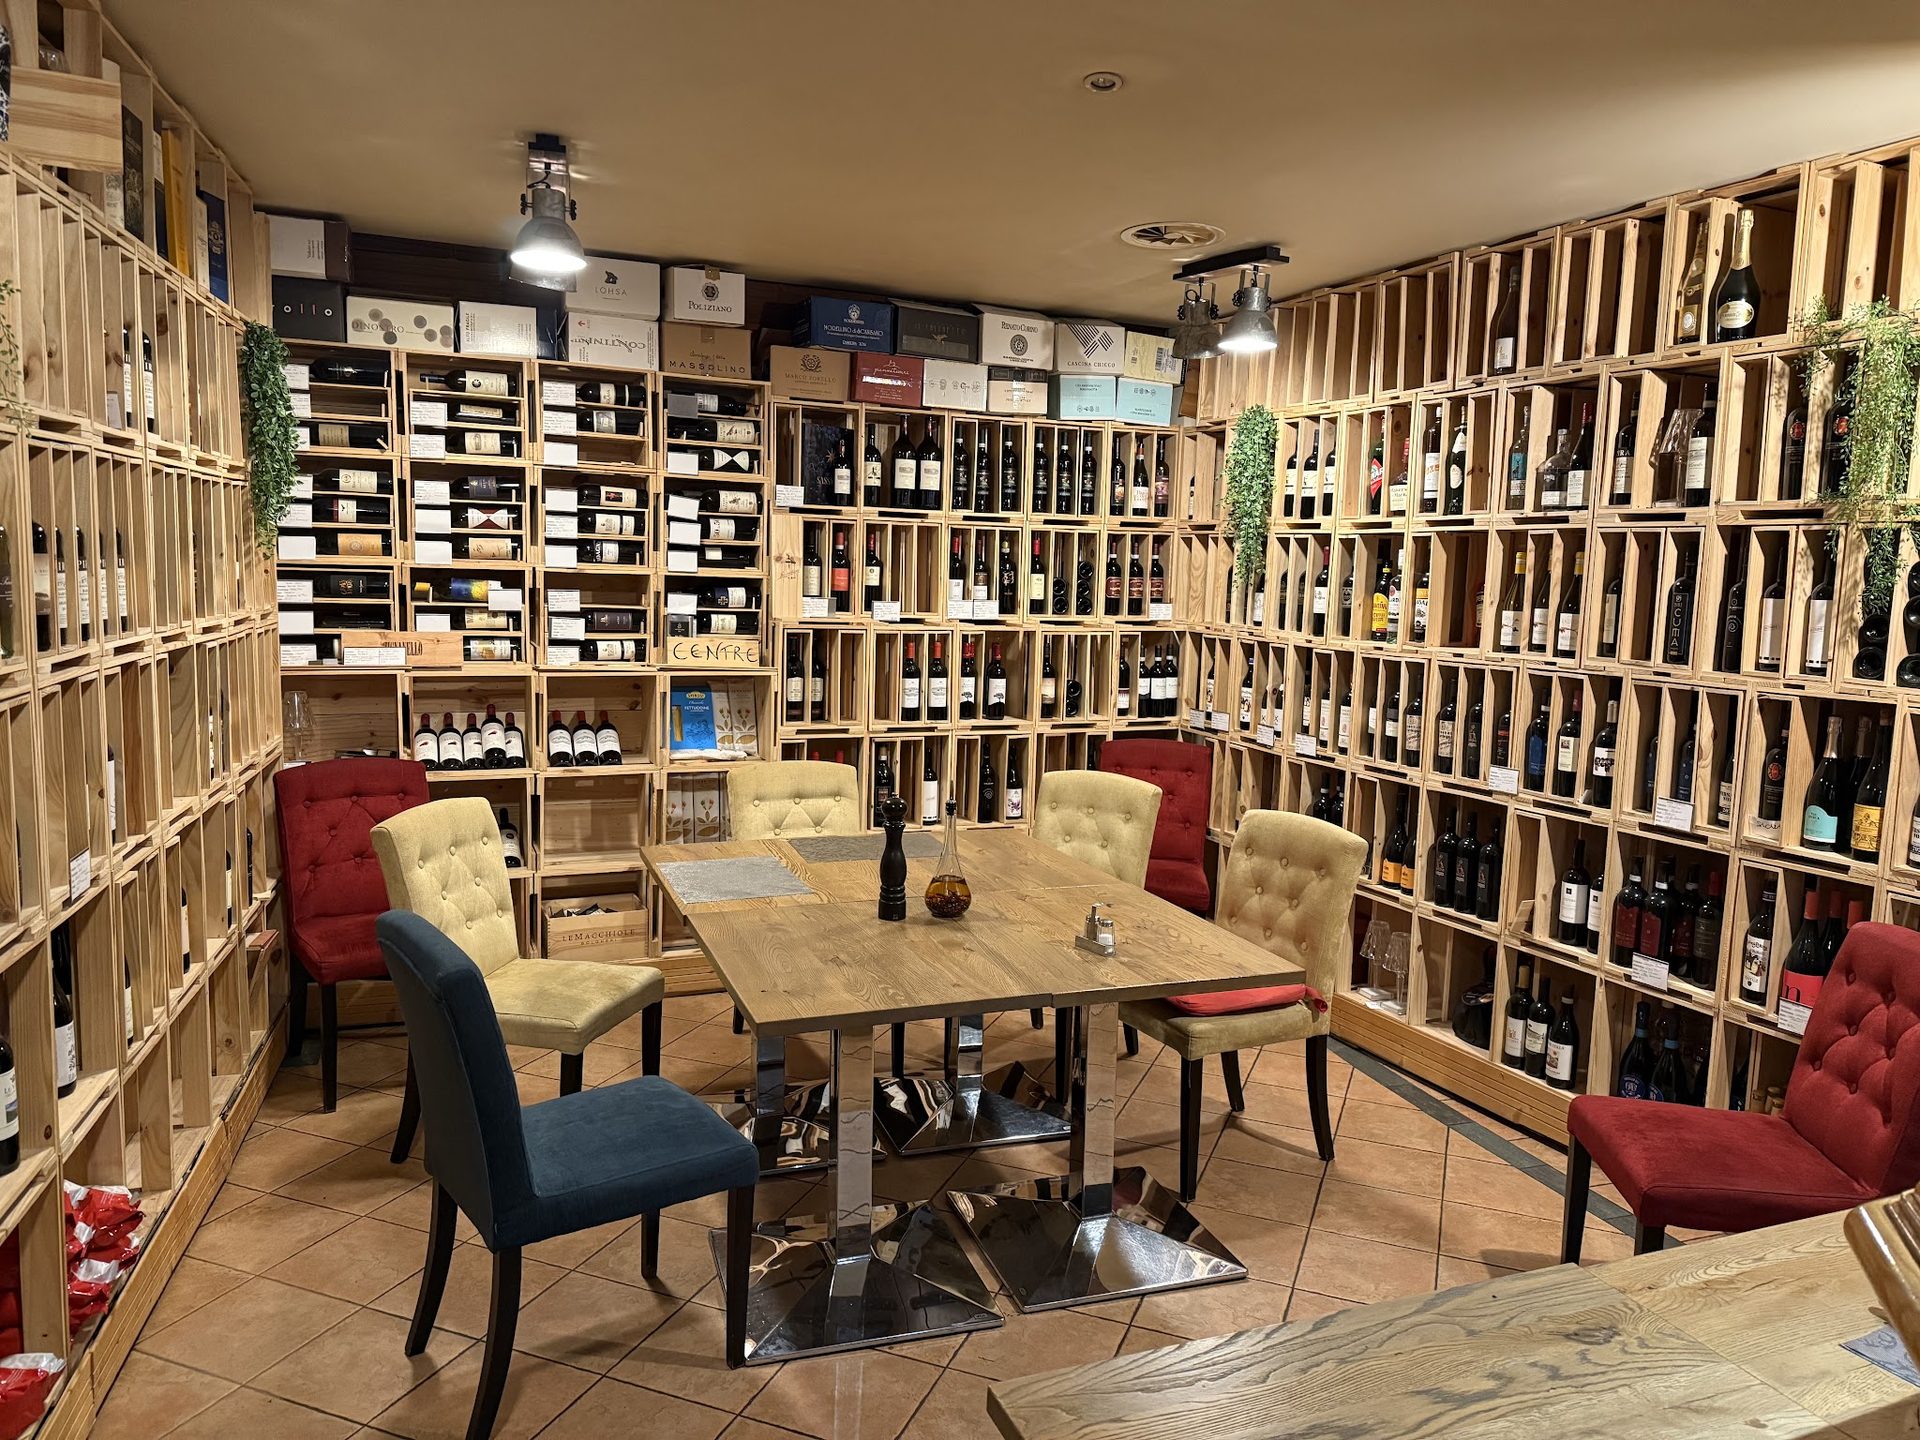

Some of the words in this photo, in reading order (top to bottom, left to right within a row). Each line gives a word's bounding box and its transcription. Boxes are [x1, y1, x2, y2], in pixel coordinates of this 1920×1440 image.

[595, 286, 628, 297] LOHSA
[688, 300, 733, 313] POLIZIANO
[1001, 320, 1021, 332] RENATO
[669, 360, 746, 374] MASSOLINO
[673, 641, 758, 663] CENTRE
